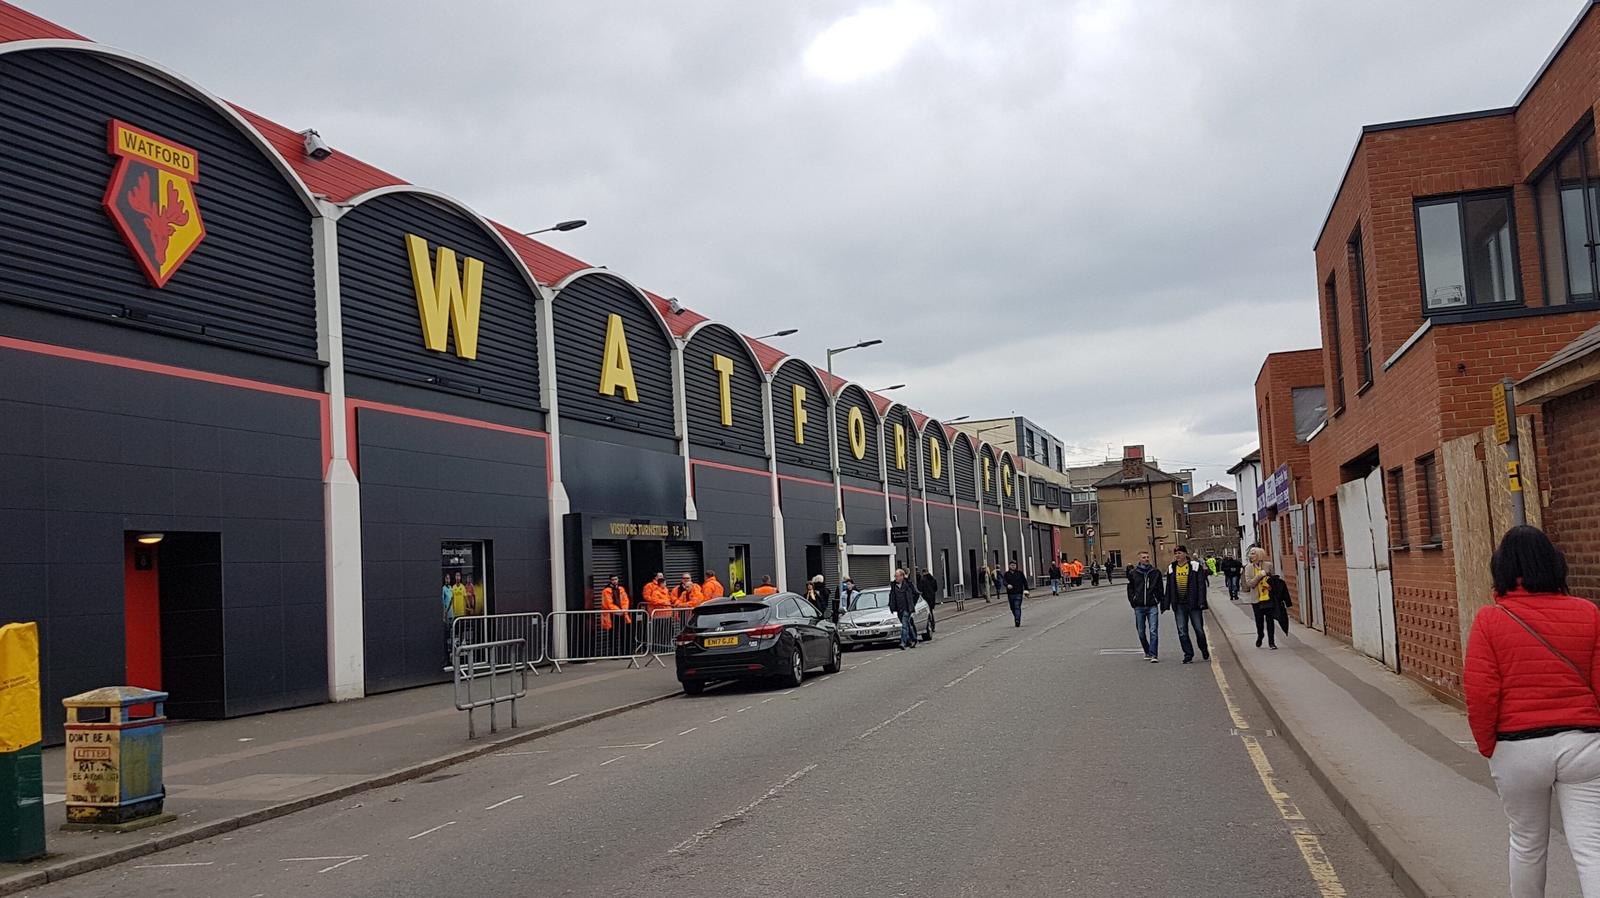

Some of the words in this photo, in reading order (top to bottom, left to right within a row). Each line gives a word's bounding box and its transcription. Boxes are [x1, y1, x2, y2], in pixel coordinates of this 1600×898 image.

[123, 130, 191, 171] WATFORD
[610, 523, 637, 535] VISITORS
[638, 524, 669, 536] TURNSTILES
[93, 733, 103, 743] BE
[105, 733, 112, 743] A
[77, 749, 108, 758] LITTER
[72, 773, 82, 781] BE
